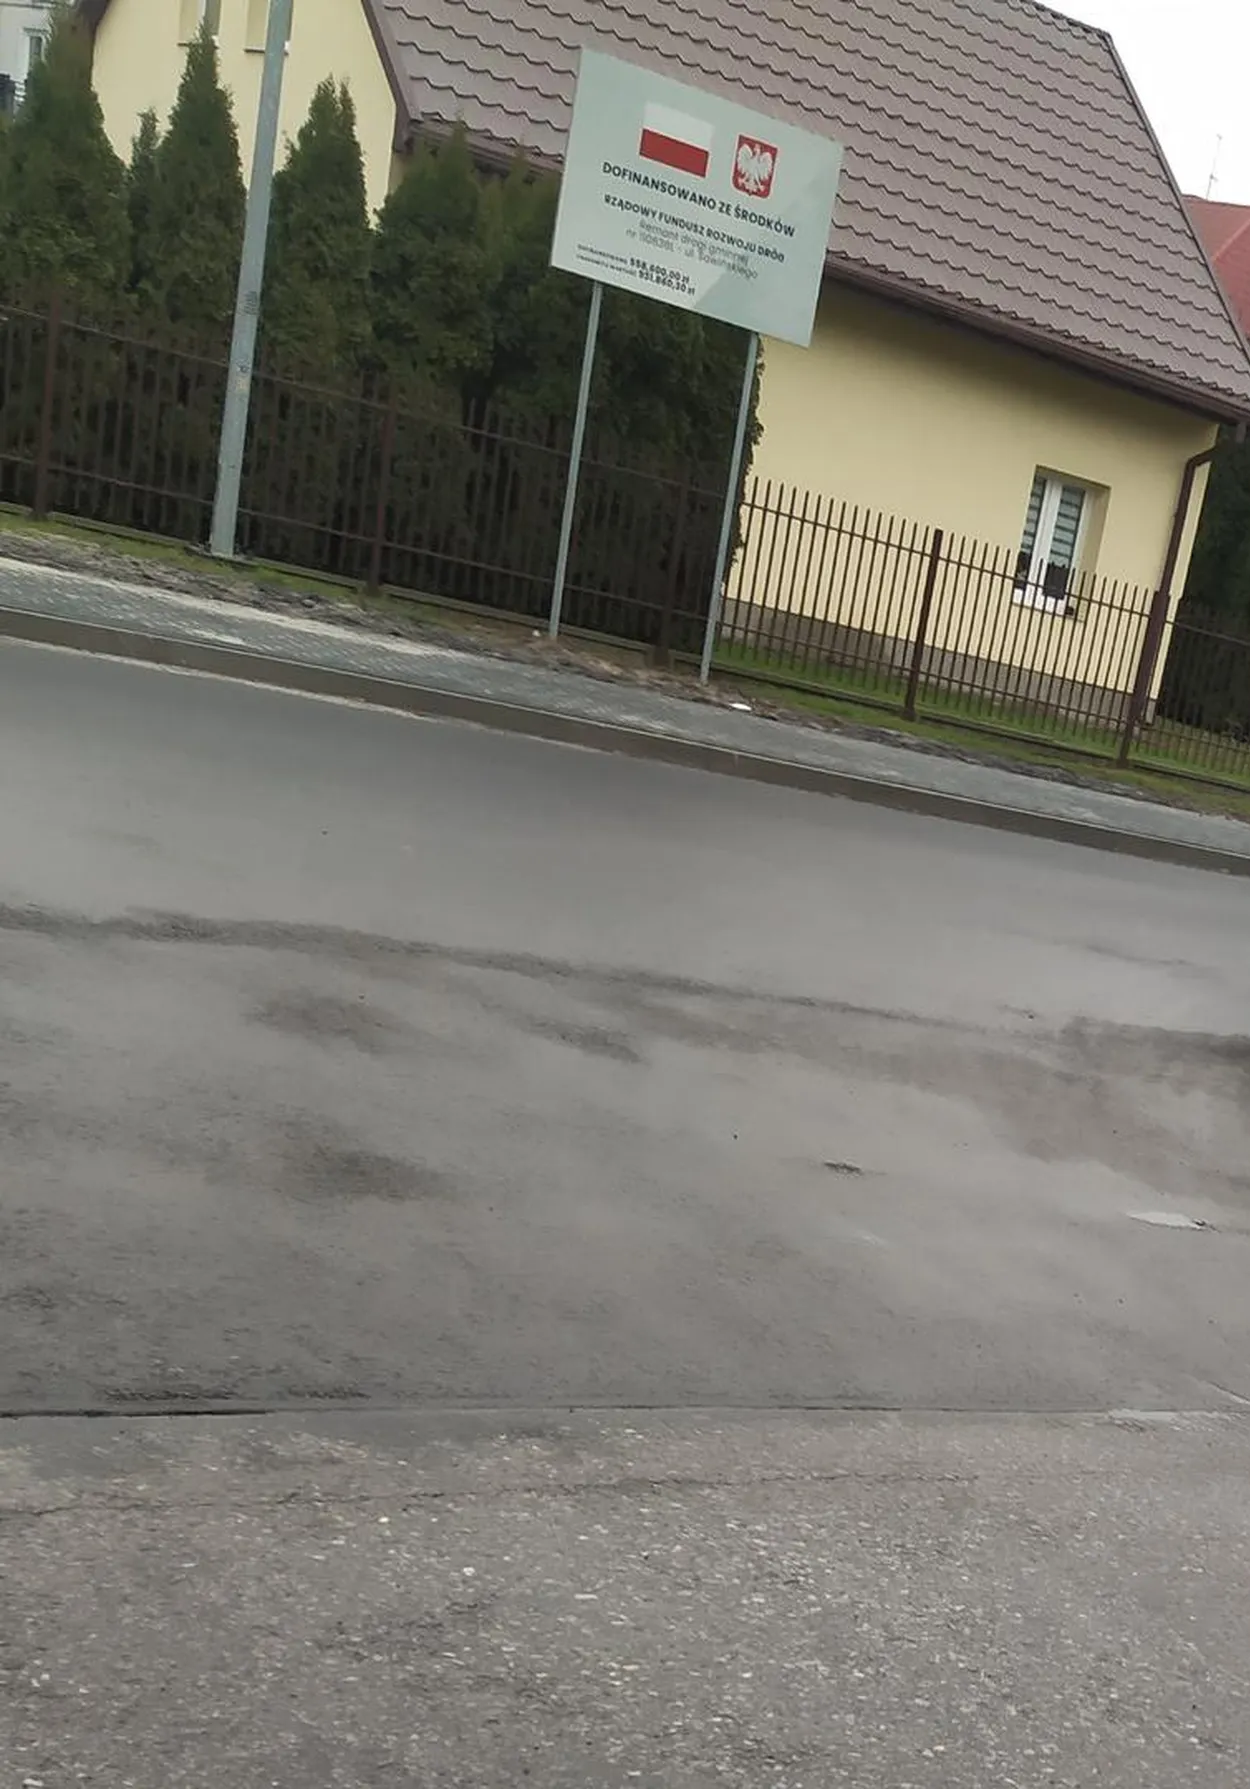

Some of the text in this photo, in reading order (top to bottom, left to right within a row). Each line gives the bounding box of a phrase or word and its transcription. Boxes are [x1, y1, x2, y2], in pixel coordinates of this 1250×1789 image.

[602, 161, 796, 238] DOFINANSOWANO ZE ŚRODKÓW
[604, 193, 785, 263] RZĄDOWY FUNDUSZ ROZWOJU DRÓG
